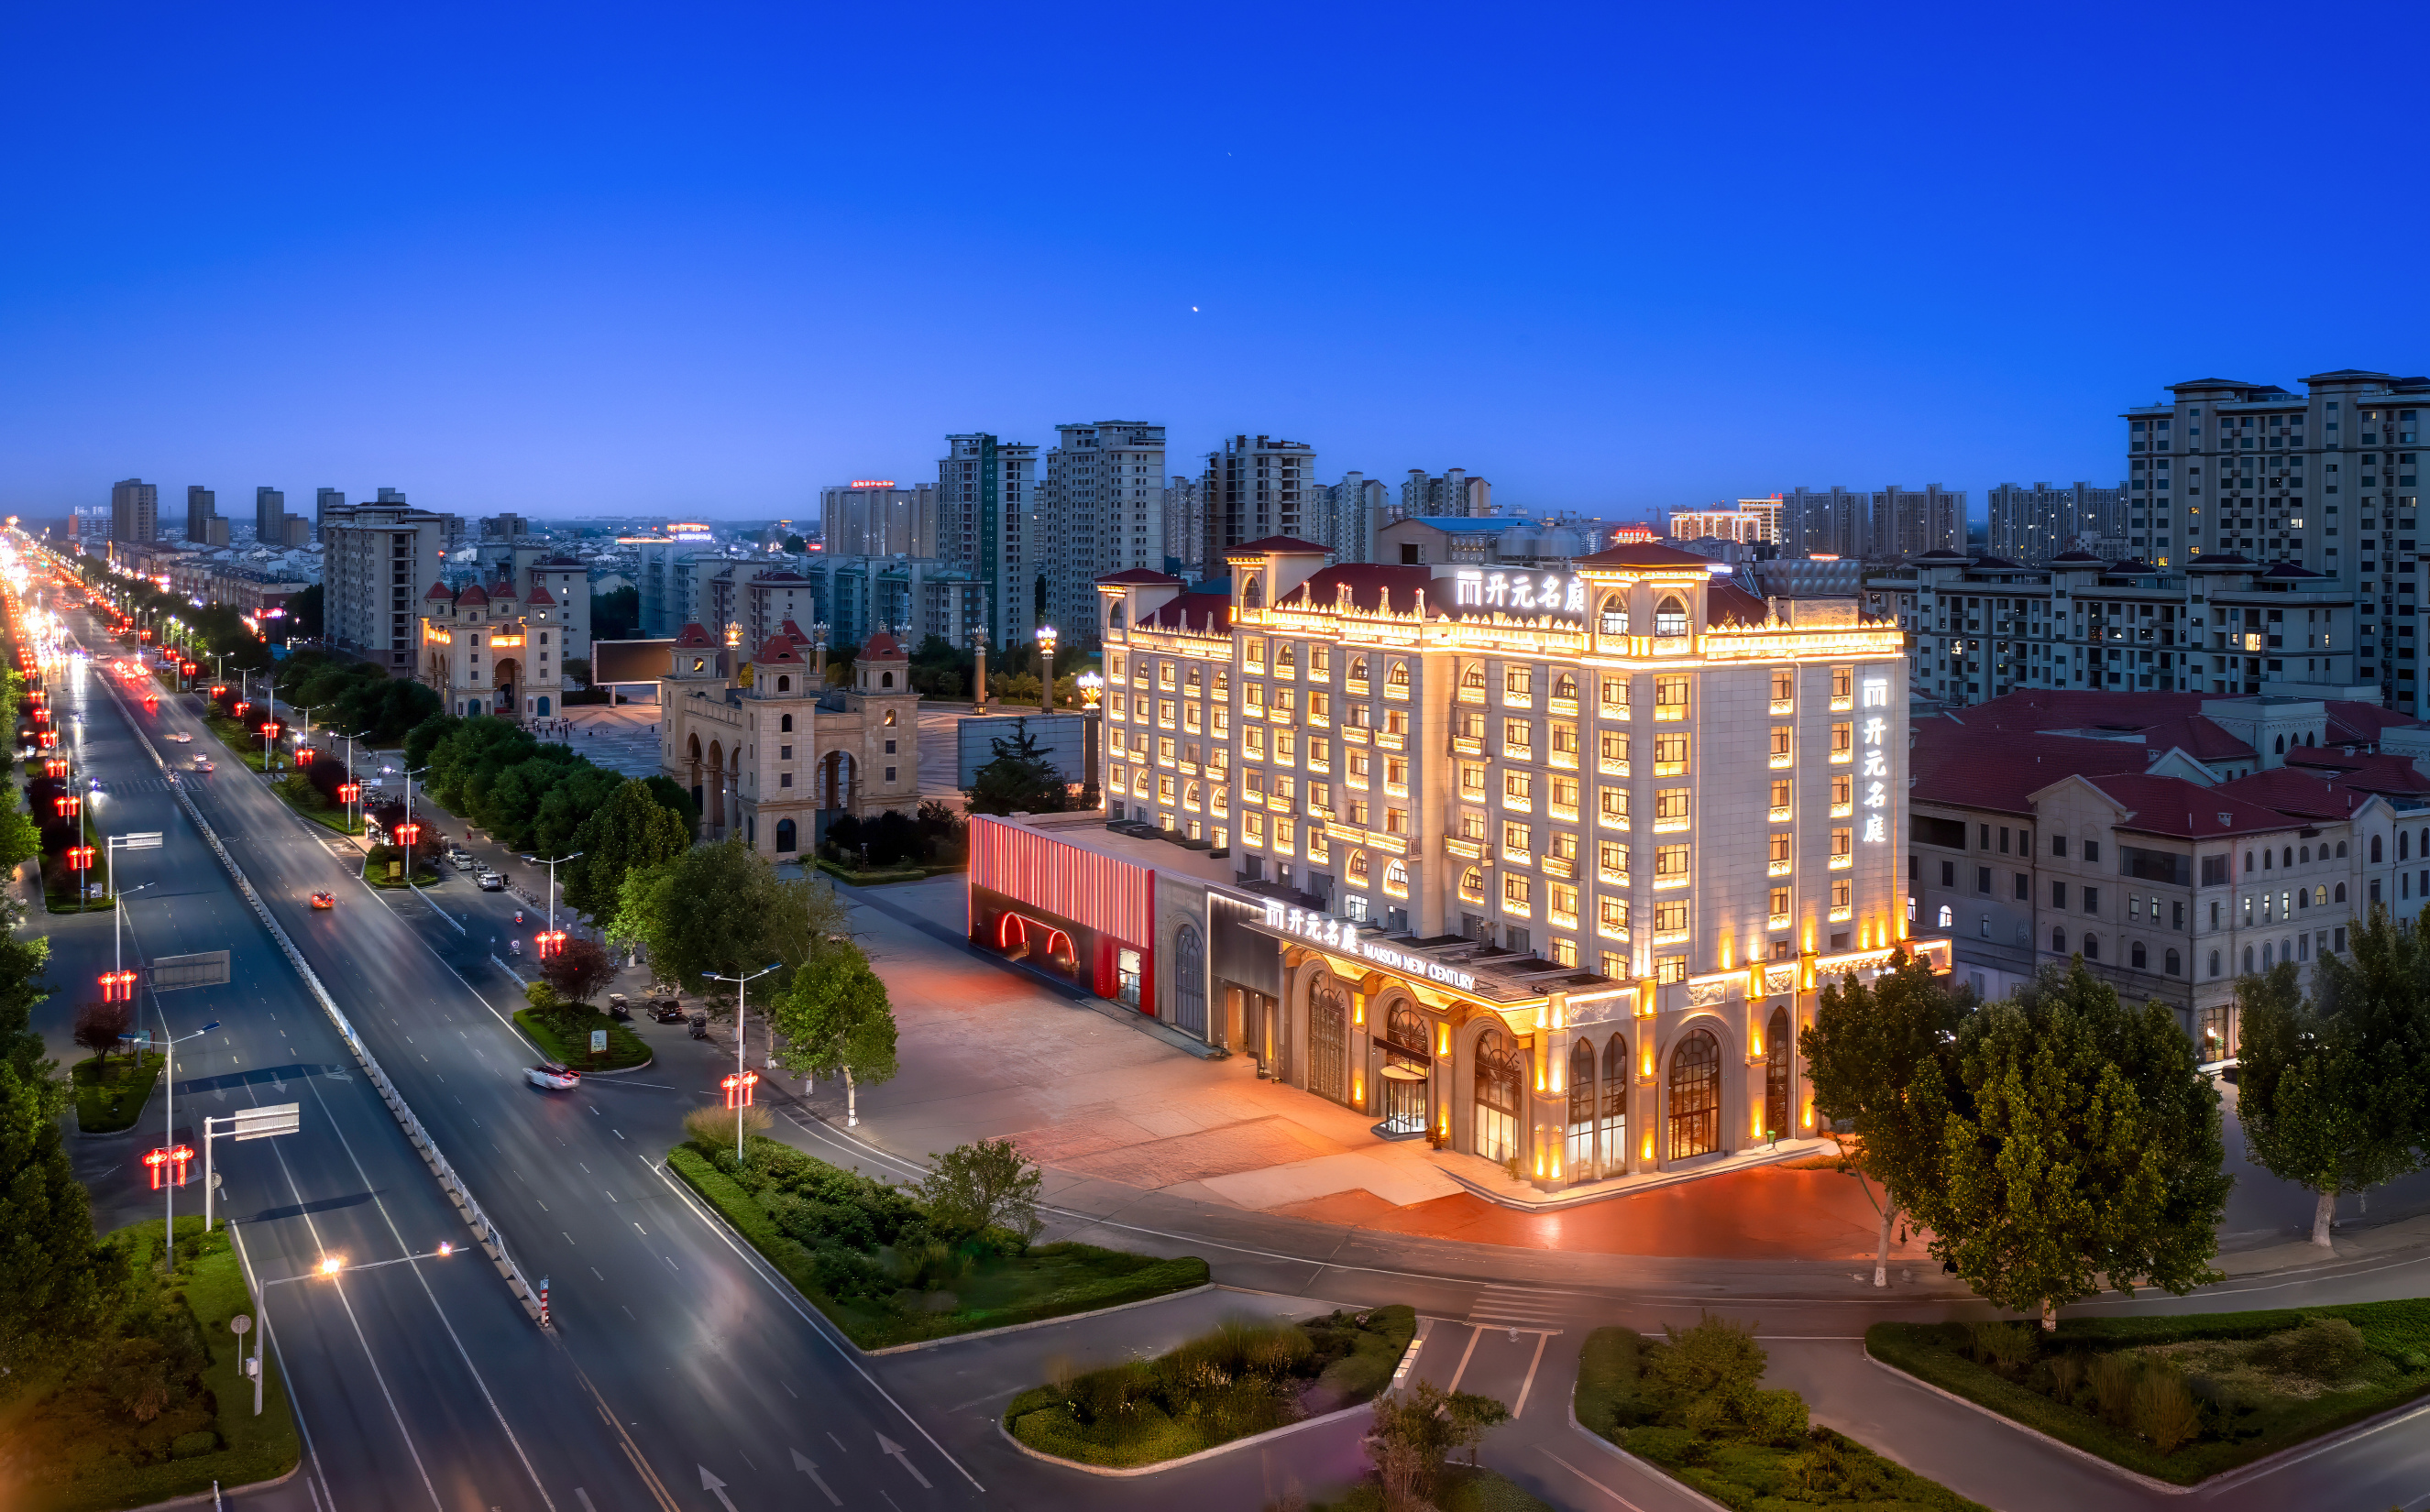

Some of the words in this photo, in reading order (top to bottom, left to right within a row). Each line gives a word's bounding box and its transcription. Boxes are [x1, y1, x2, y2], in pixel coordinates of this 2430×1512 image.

[1863, 718, 1887, 842] 开元名庭
[1288, 908, 1359, 954] 开元名庭
[1363, 943, 1402, 969] MAISON
[1402, 955, 1427, 976] NEW
[1428, 963, 1475, 991] CENTURY
